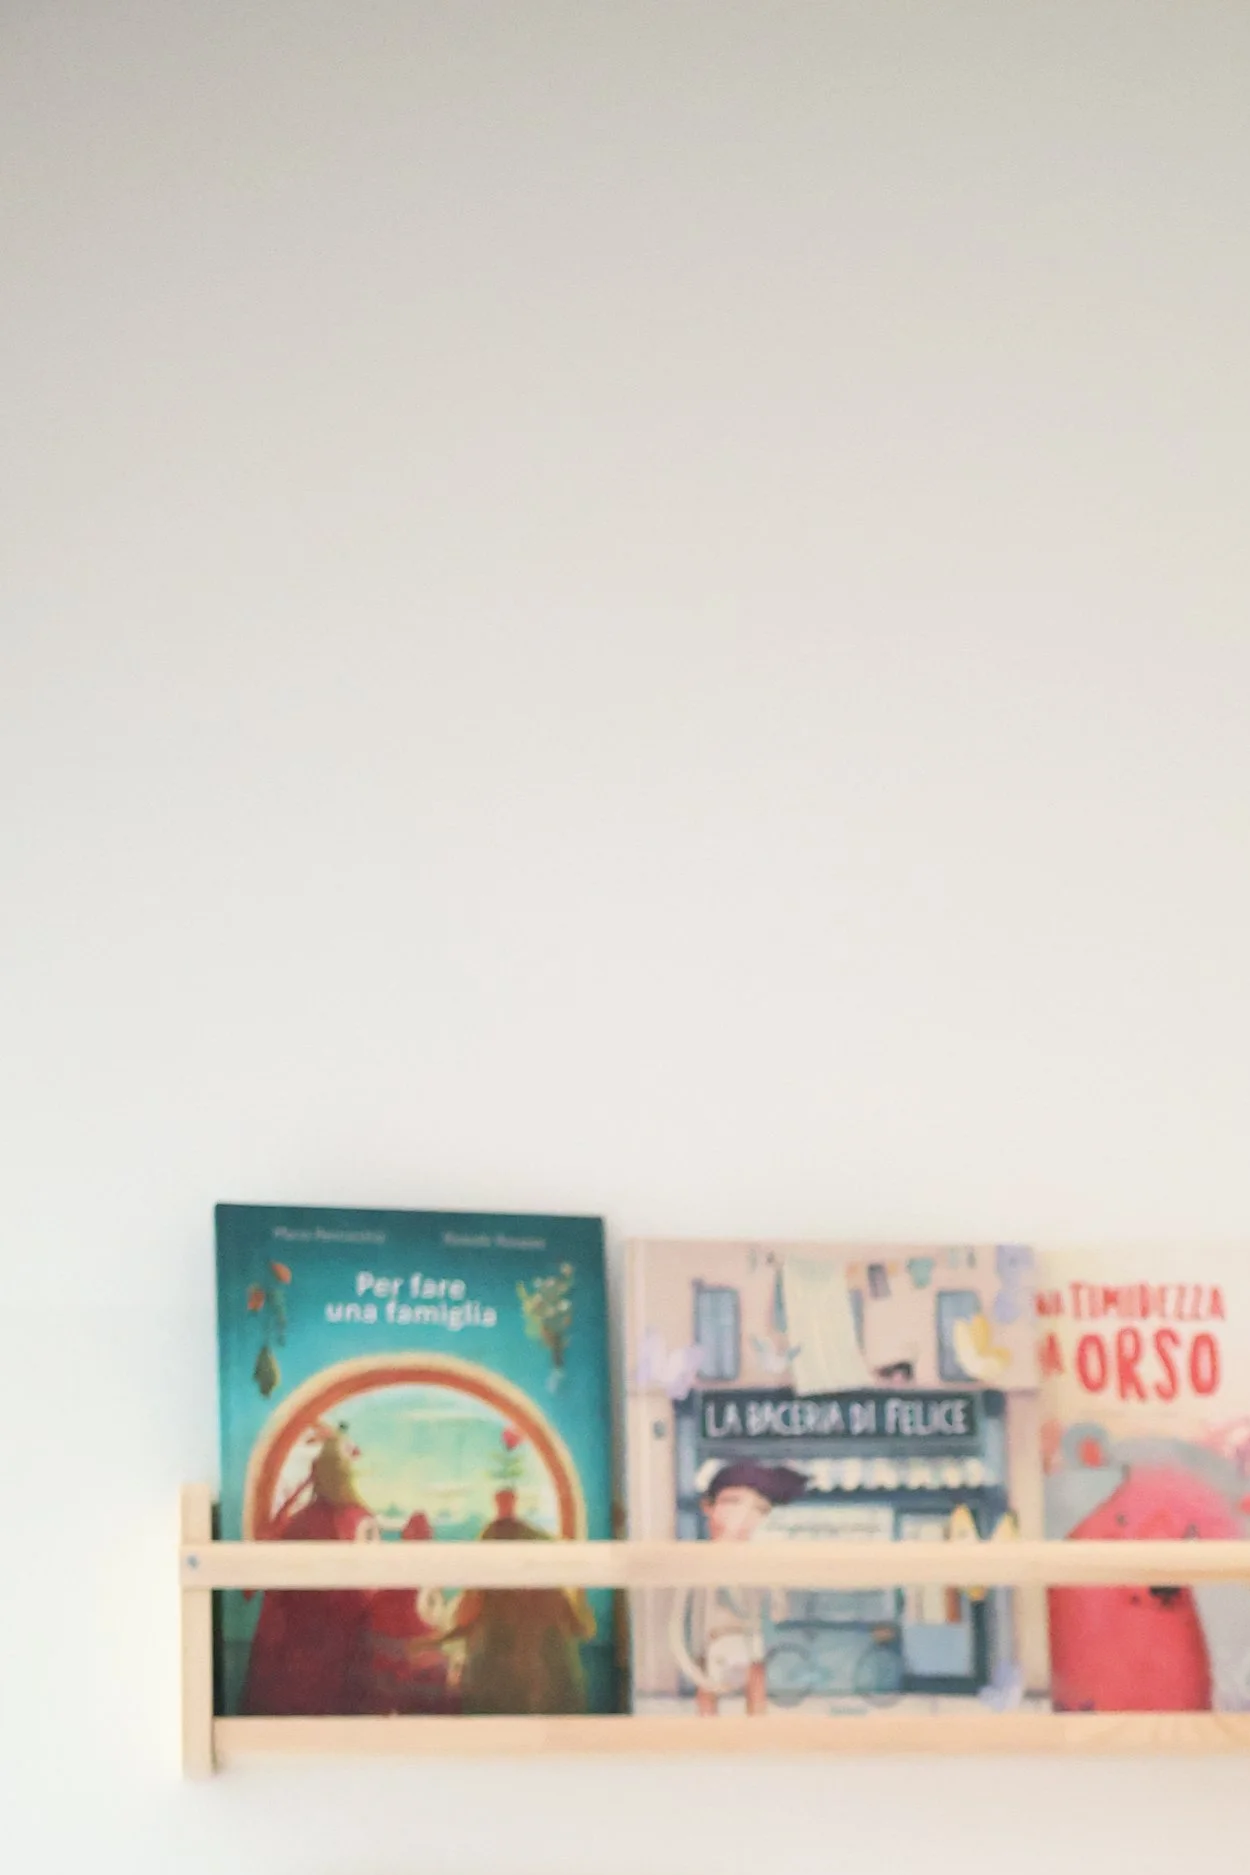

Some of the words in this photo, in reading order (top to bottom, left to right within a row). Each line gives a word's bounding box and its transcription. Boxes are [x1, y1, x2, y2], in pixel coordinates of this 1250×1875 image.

[356, 1270, 403, 1298] Per
[409, 1271, 466, 1300] fare
[325, 1302, 377, 1324] una
[385, 1300, 497, 1331] famiglia
[1076, 1326, 1220, 1402] ORSO
[705, 1401, 743, 1438] LA
[746, 1400, 845, 1436] BACERIA
[850, 1401, 877, 1435] DI
[884, 1398, 968, 1435] FELICE
